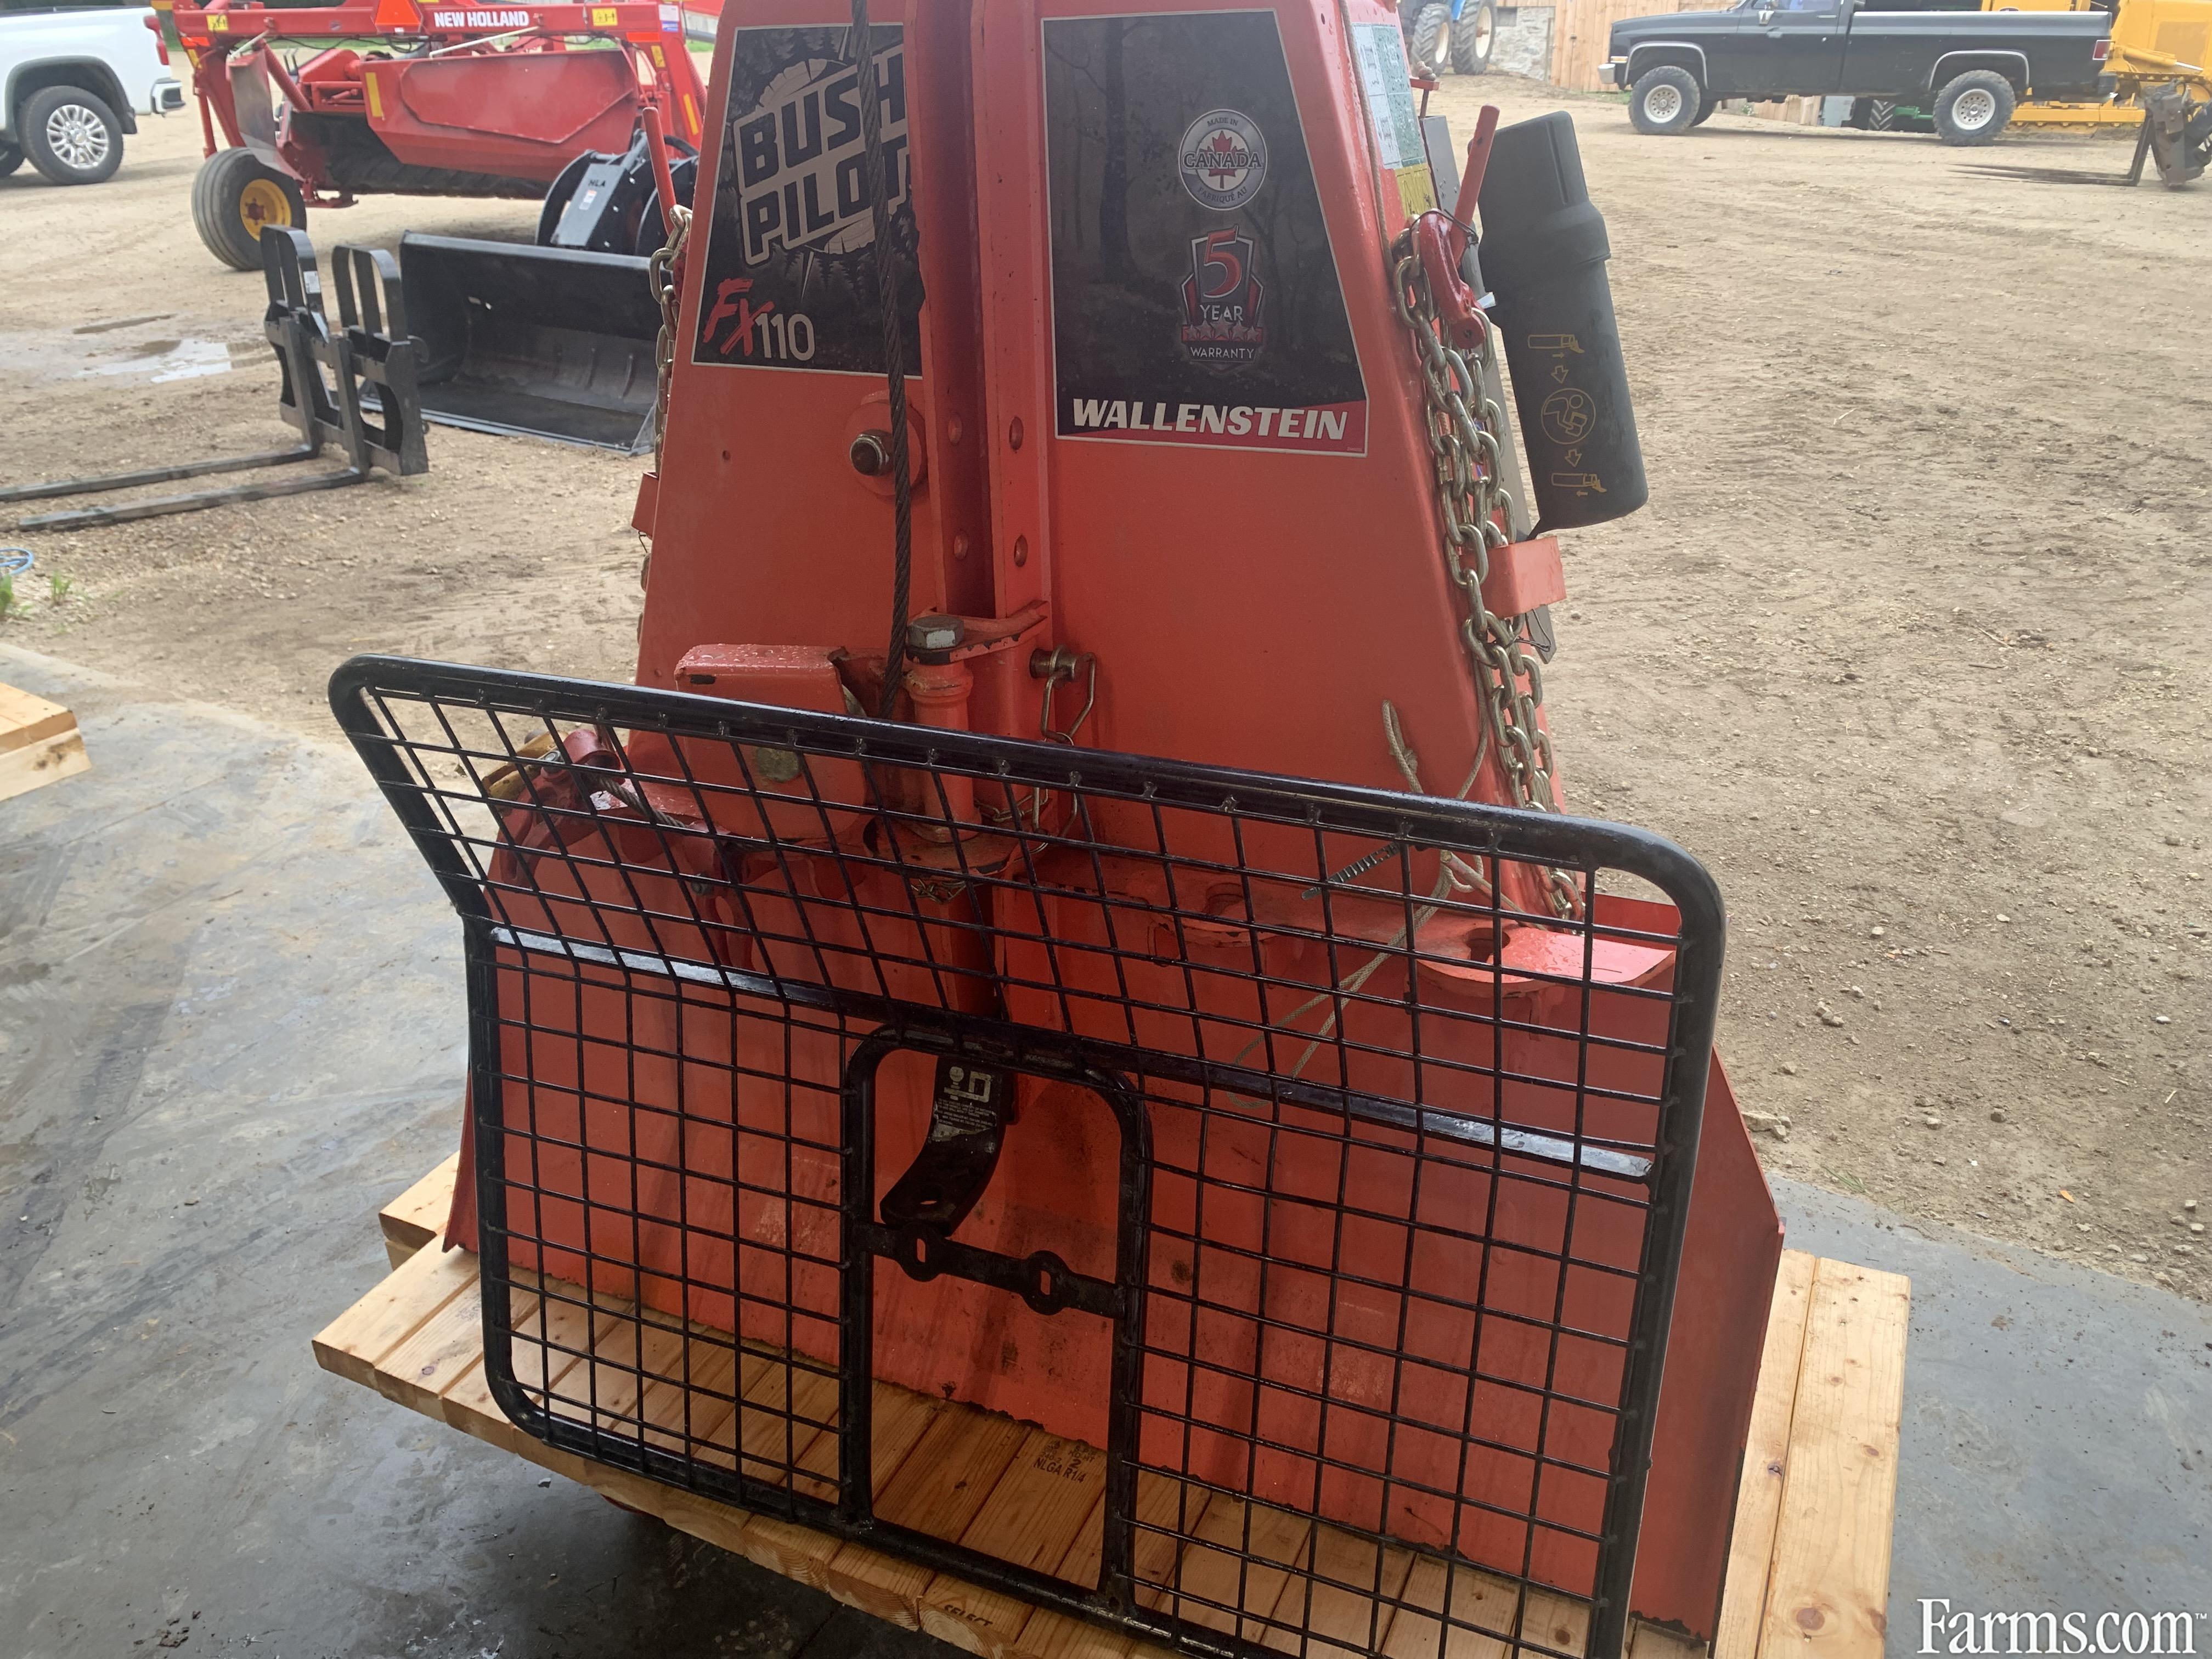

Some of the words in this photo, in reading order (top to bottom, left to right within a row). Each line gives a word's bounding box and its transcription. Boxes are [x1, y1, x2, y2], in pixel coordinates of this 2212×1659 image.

[433, 12, 465, 27] NEW
[466, 10, 529, 27] HOLLAND
[738, 52, 906, 188] BUSH
[1207, 117, 1228, 127] MADE
[1230, 118, 1238, 126] IN
[1183, 151, 1264, 170] CANADA
[745, 135, 909, 258] PILOT
[1198, 186, 1236, 203] FABRIQUÉ
[1237, 185, 1248, 199] AU
[1203, 224, 1242, 298] 5
[1200, 304, 1243, 323] YEAR
[1190, 346, 1255, 360] WARRANTY
[1073, 398, 1348, 441] WALLENSTEIN
[1033, 1457, 1063, 1475] NLGA
[1062, 1467, 1087, 1483] R1/4
[1069, 1458, 1082, 1469] 2
